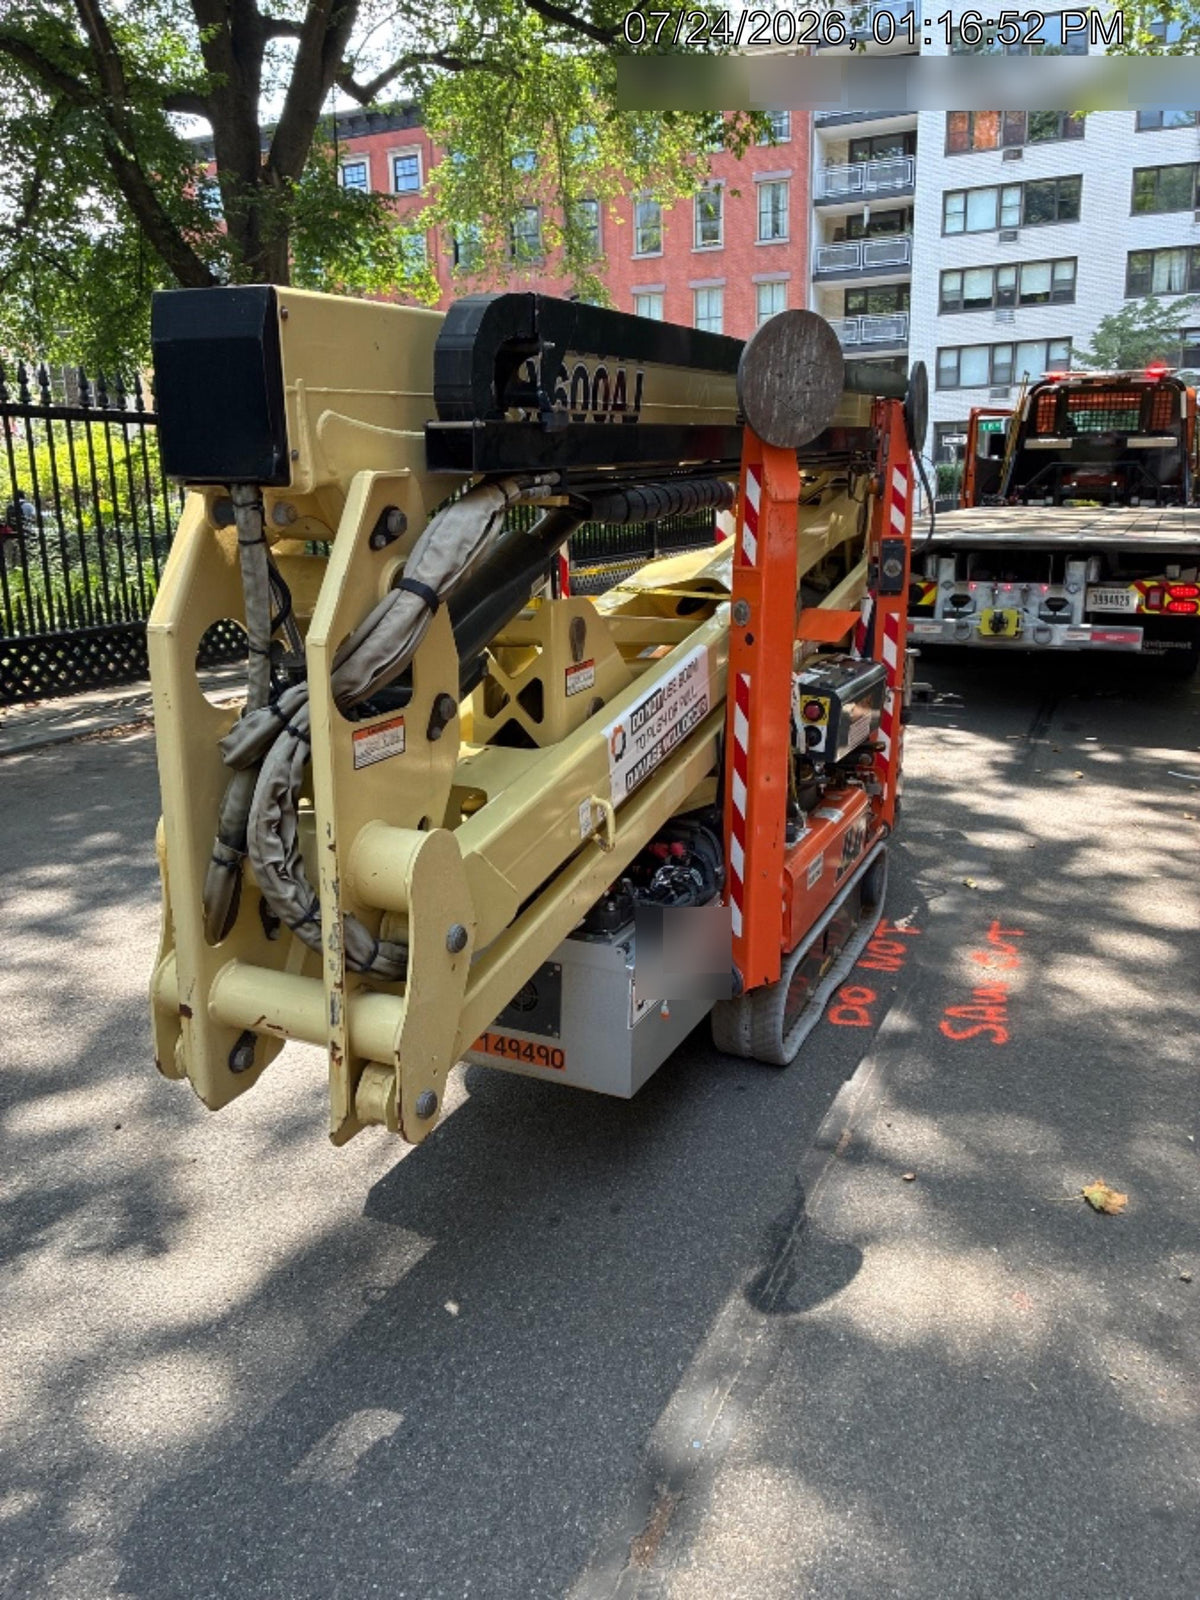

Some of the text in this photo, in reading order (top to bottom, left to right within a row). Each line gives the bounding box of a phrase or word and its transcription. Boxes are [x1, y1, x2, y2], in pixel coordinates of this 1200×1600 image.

[632, 708, 644, 732] DO
[645, 692, 663, 718] NOT
[635, 734, 646, 752] TO
[627, 743, 662, 790] DAMAGE
[828, 918, 922, 1027] DO NOT
[939, 979, 1010, 1044] SAW
[480, 1032, 565, 1070] 149490
